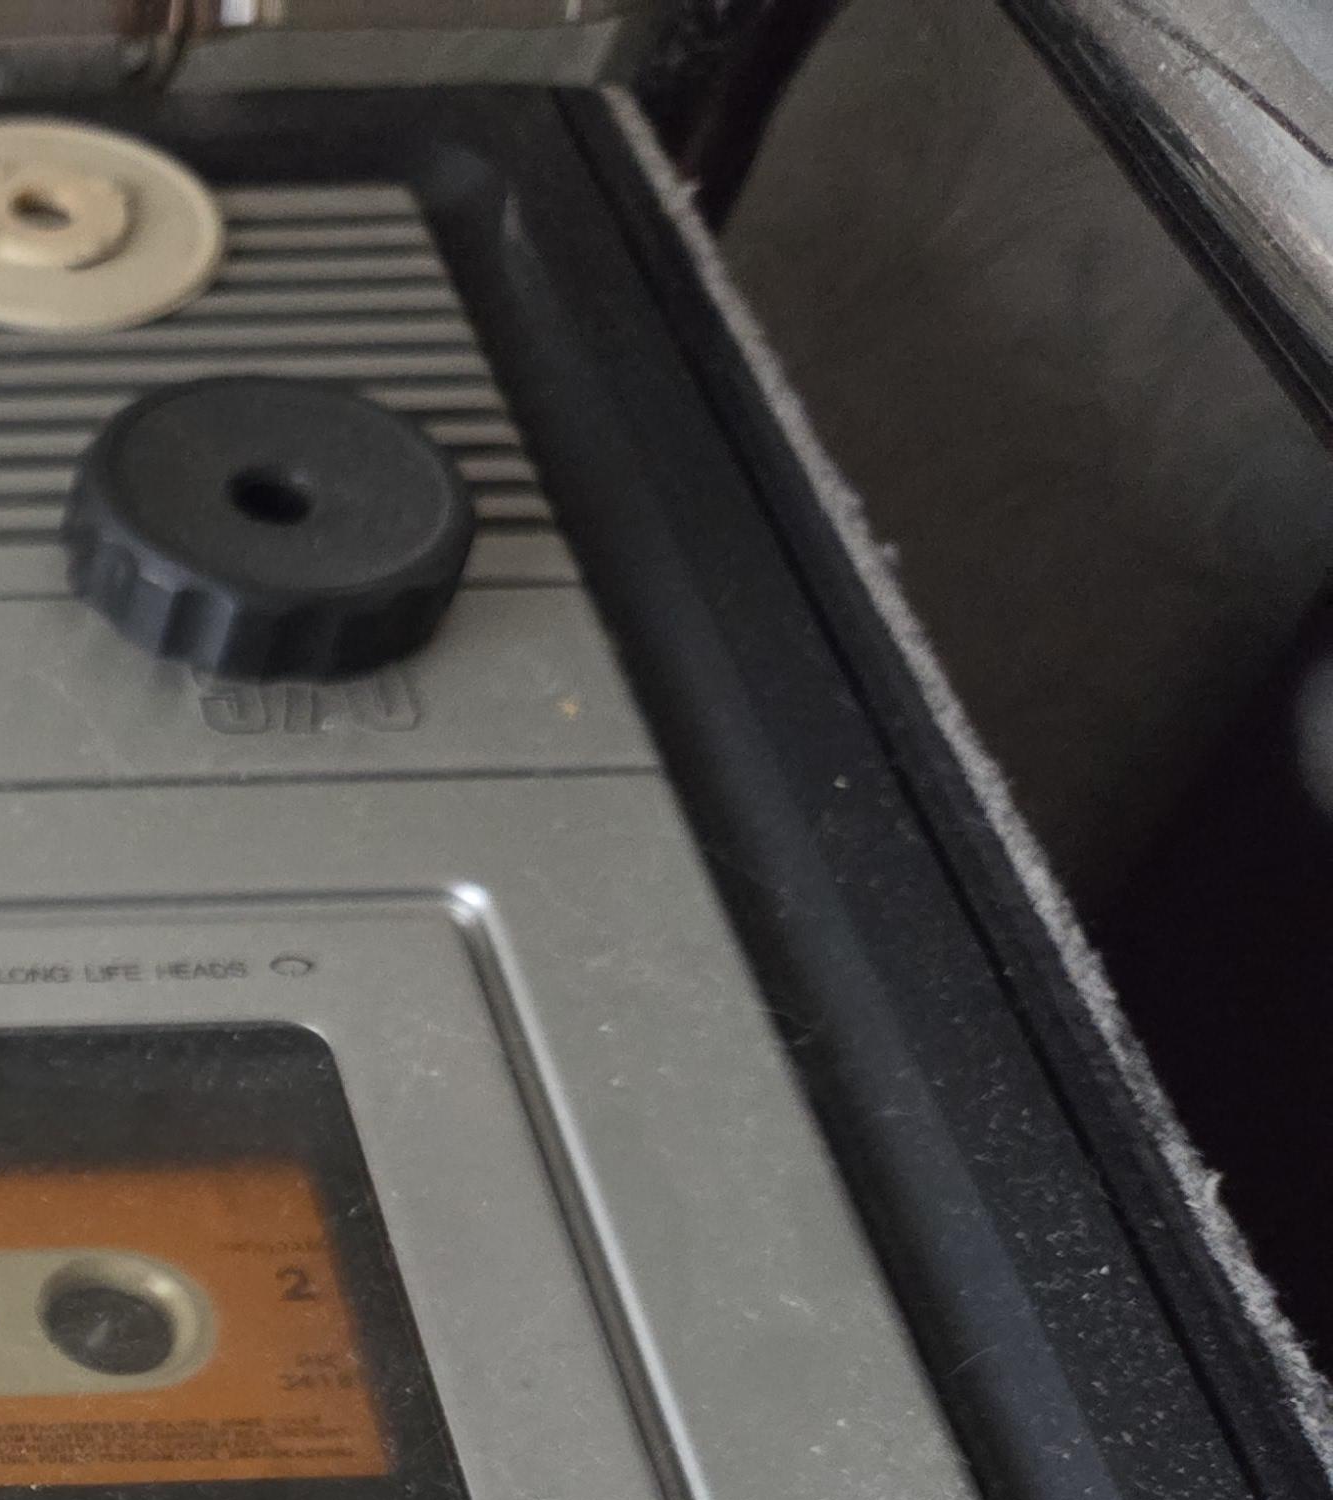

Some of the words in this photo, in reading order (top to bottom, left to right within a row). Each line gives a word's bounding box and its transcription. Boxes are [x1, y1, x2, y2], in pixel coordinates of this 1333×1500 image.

[84, 963, 143, 984] LIFE
[156, 959, 247, 981] HEADS
[275, 1266, 318, 1302] 2
